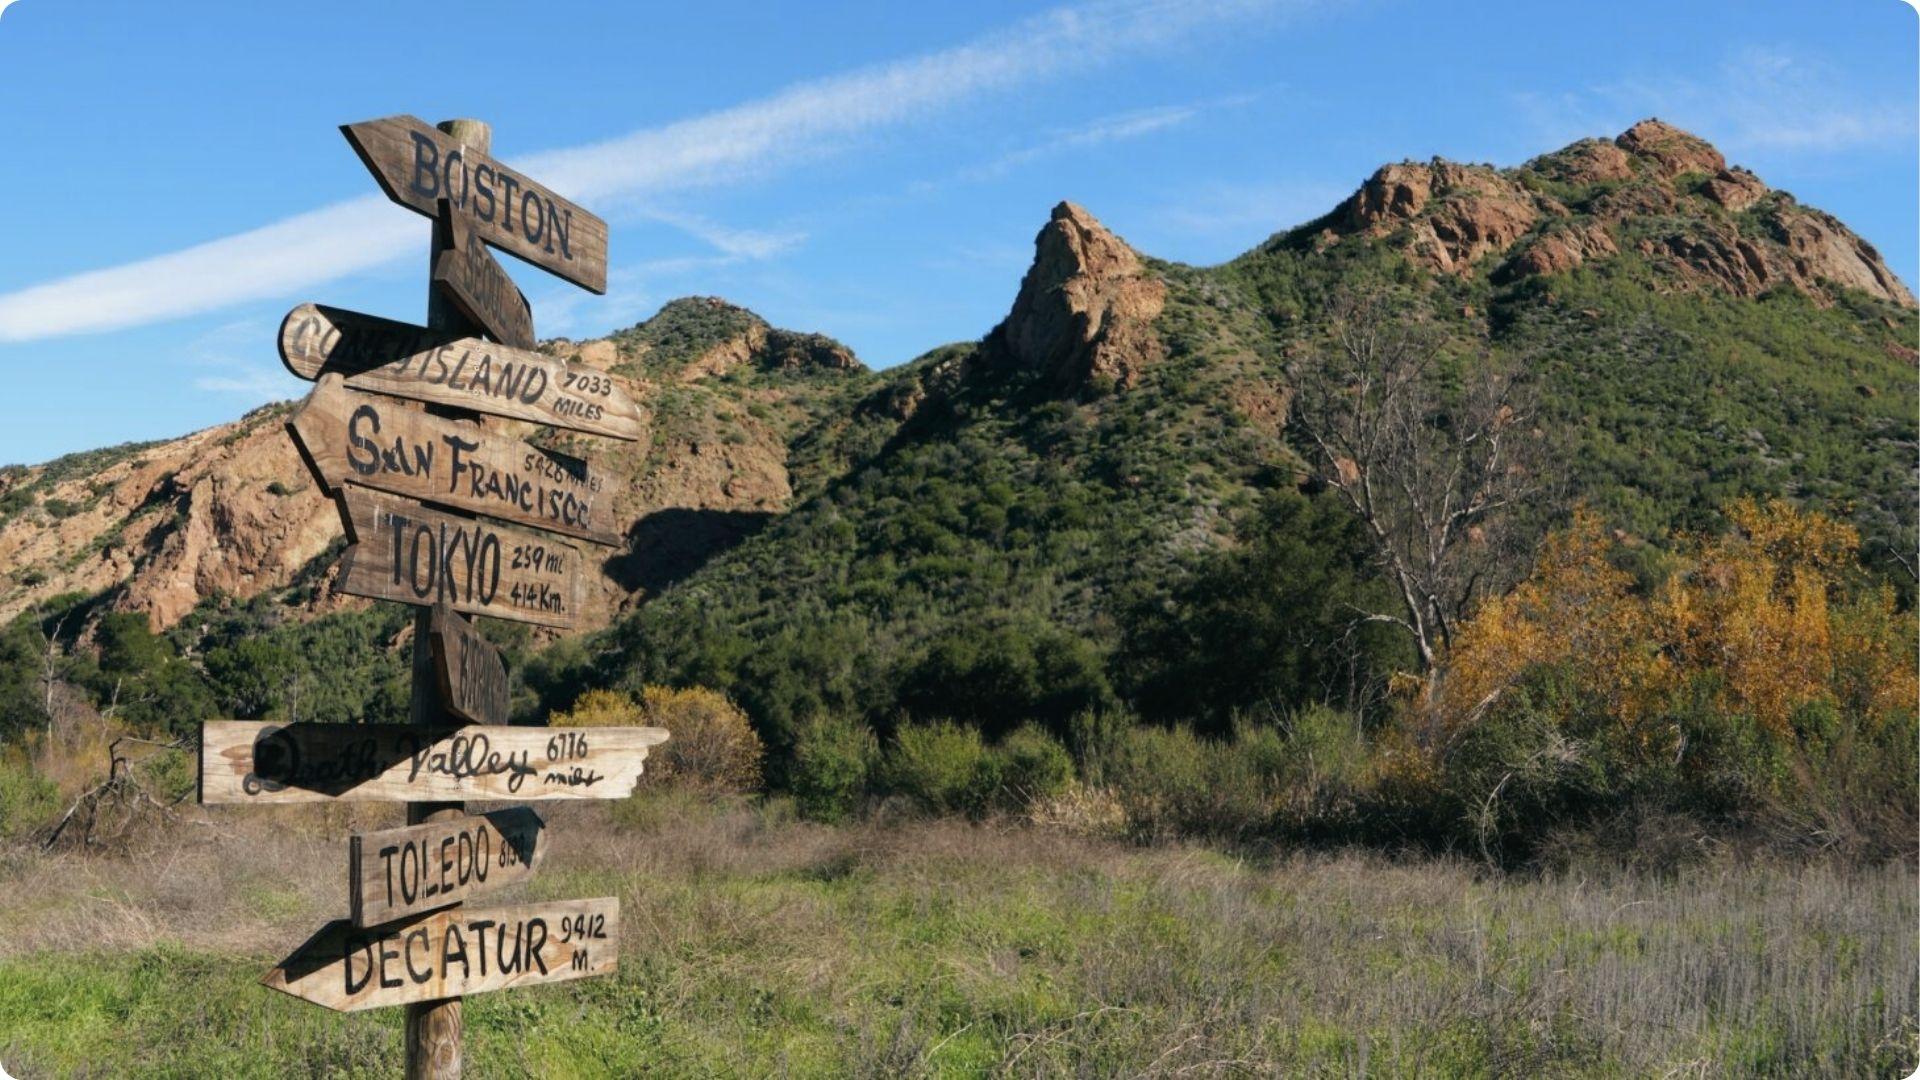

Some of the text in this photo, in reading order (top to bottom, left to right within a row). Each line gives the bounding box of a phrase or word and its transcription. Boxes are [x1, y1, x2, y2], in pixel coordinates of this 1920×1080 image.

[409, 130, 573, 260] BOSTON
[292, 317, 612, 405] COY ISLAND 7033
[553, 397, 604, 421] MILES
[385, 512, 501, 606] TOKYO
[511, 544, 544, 573] 259
[396, 731, 538, 793] Valley
[379, 825, 490, 908] TOLEDO
[343, 914, 607, 996] DECATUR 9412
[572, 949, 595, 972] M.
